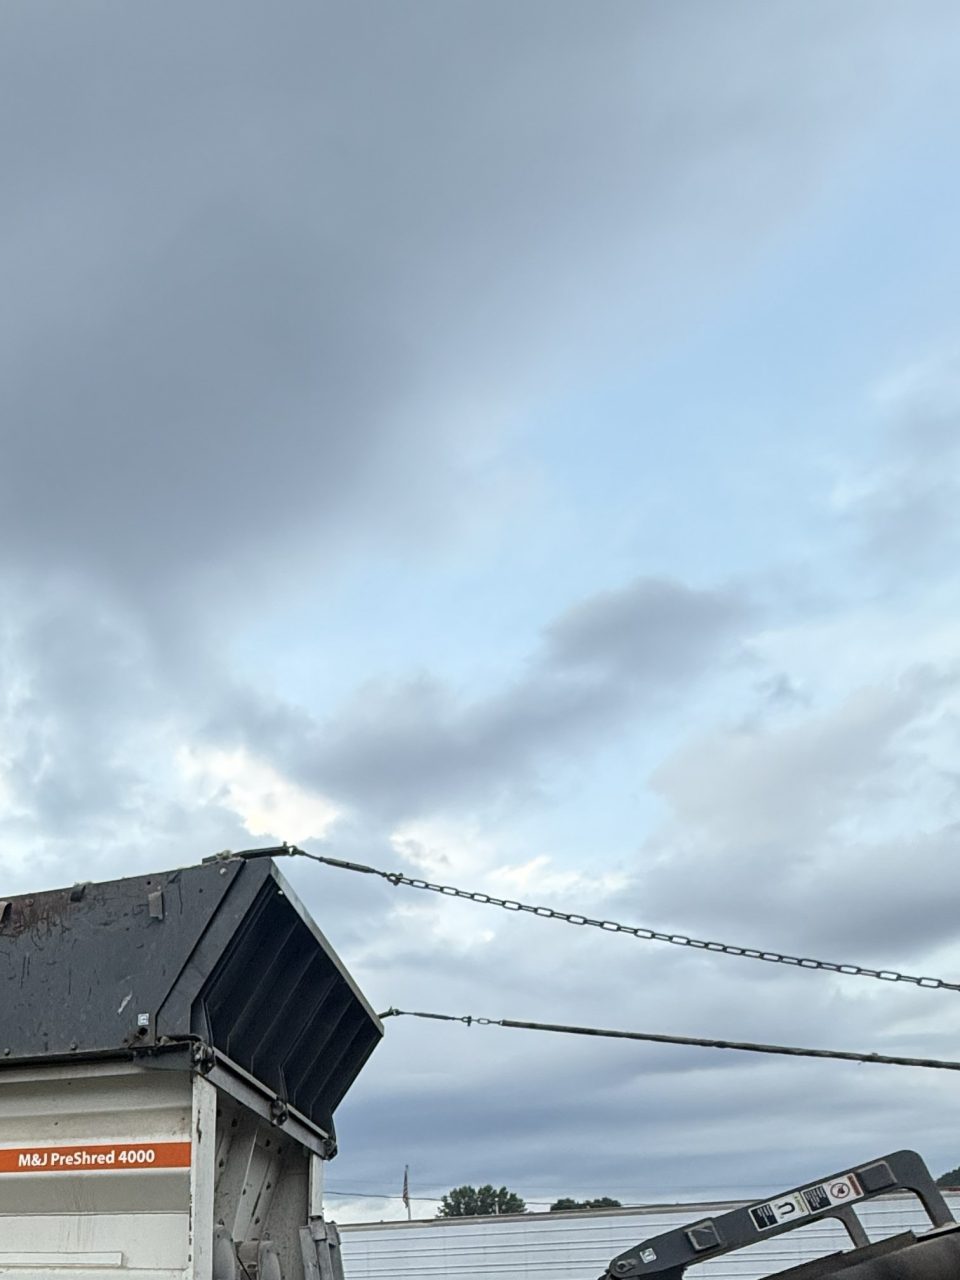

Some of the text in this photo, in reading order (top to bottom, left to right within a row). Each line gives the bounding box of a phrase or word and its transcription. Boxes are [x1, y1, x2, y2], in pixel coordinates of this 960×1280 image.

[18, 1149, 156, 1167] M&J PreShred 4000
